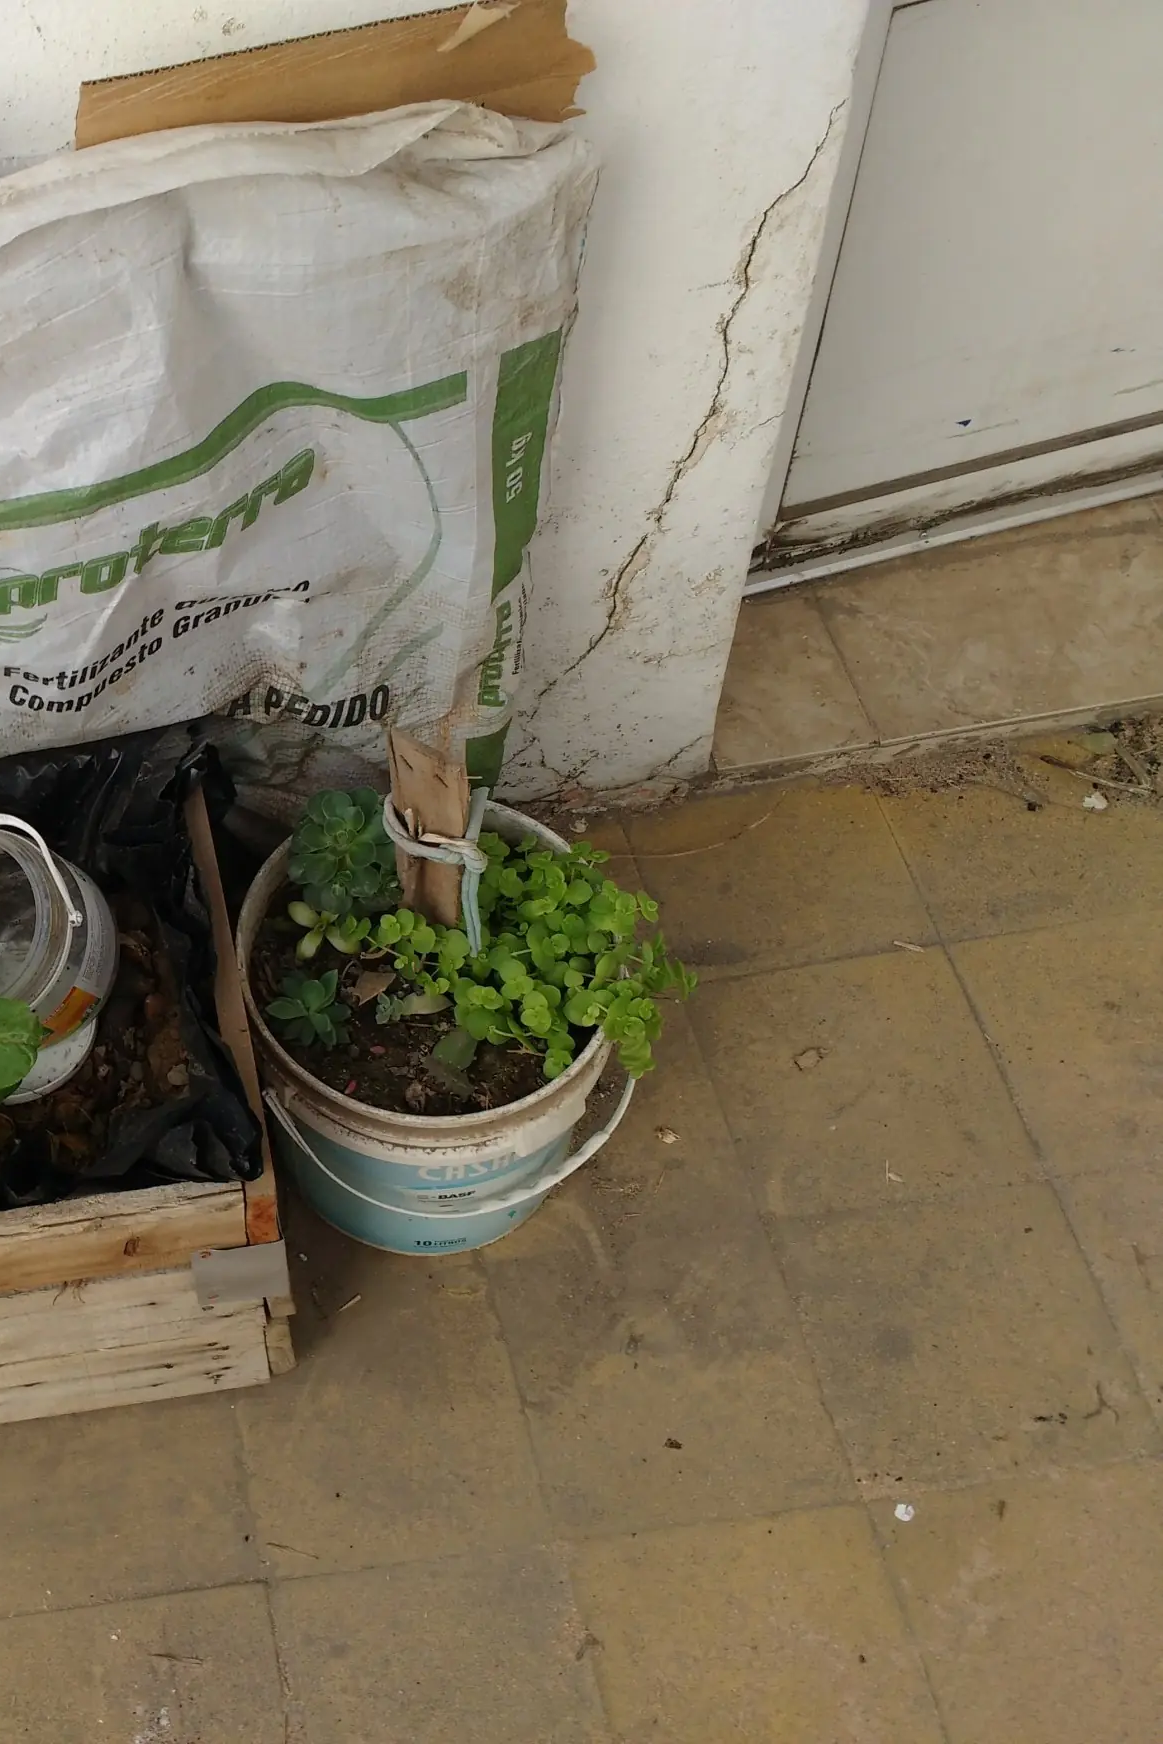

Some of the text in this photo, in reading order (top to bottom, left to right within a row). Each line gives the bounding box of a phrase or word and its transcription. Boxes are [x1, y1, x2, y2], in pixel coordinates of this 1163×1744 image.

[505, 431, 533, 504] 50 kg
[3, 608, 164, 690] Fertilizante
[8, 636, 163, 713] Compuesto
[172, 593, 311, 639] Granul
[226, 684, 390, 729] A PEDIDO
